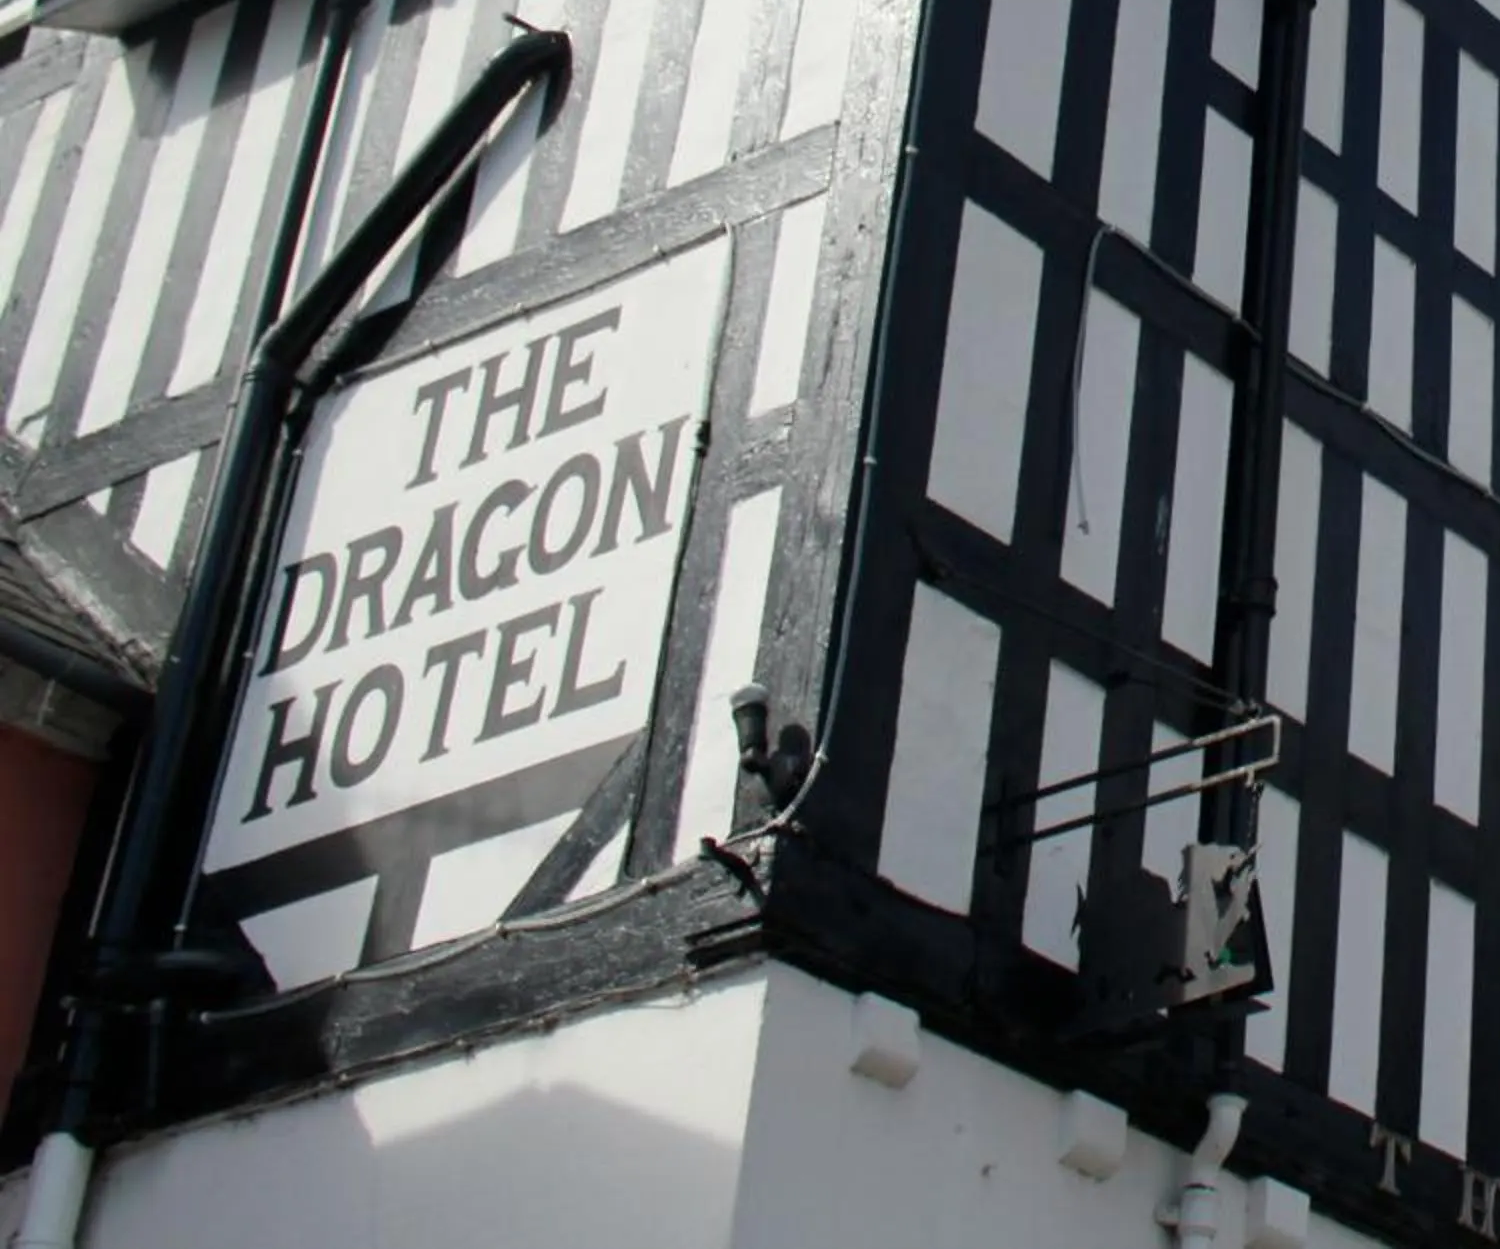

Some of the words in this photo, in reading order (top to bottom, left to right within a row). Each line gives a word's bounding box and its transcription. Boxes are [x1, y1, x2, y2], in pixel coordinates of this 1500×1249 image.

[405, 305, 621, 490] THE
[258, 415, 690, 677] DRAGON
[241, 587, 626, 824] HOTEL
